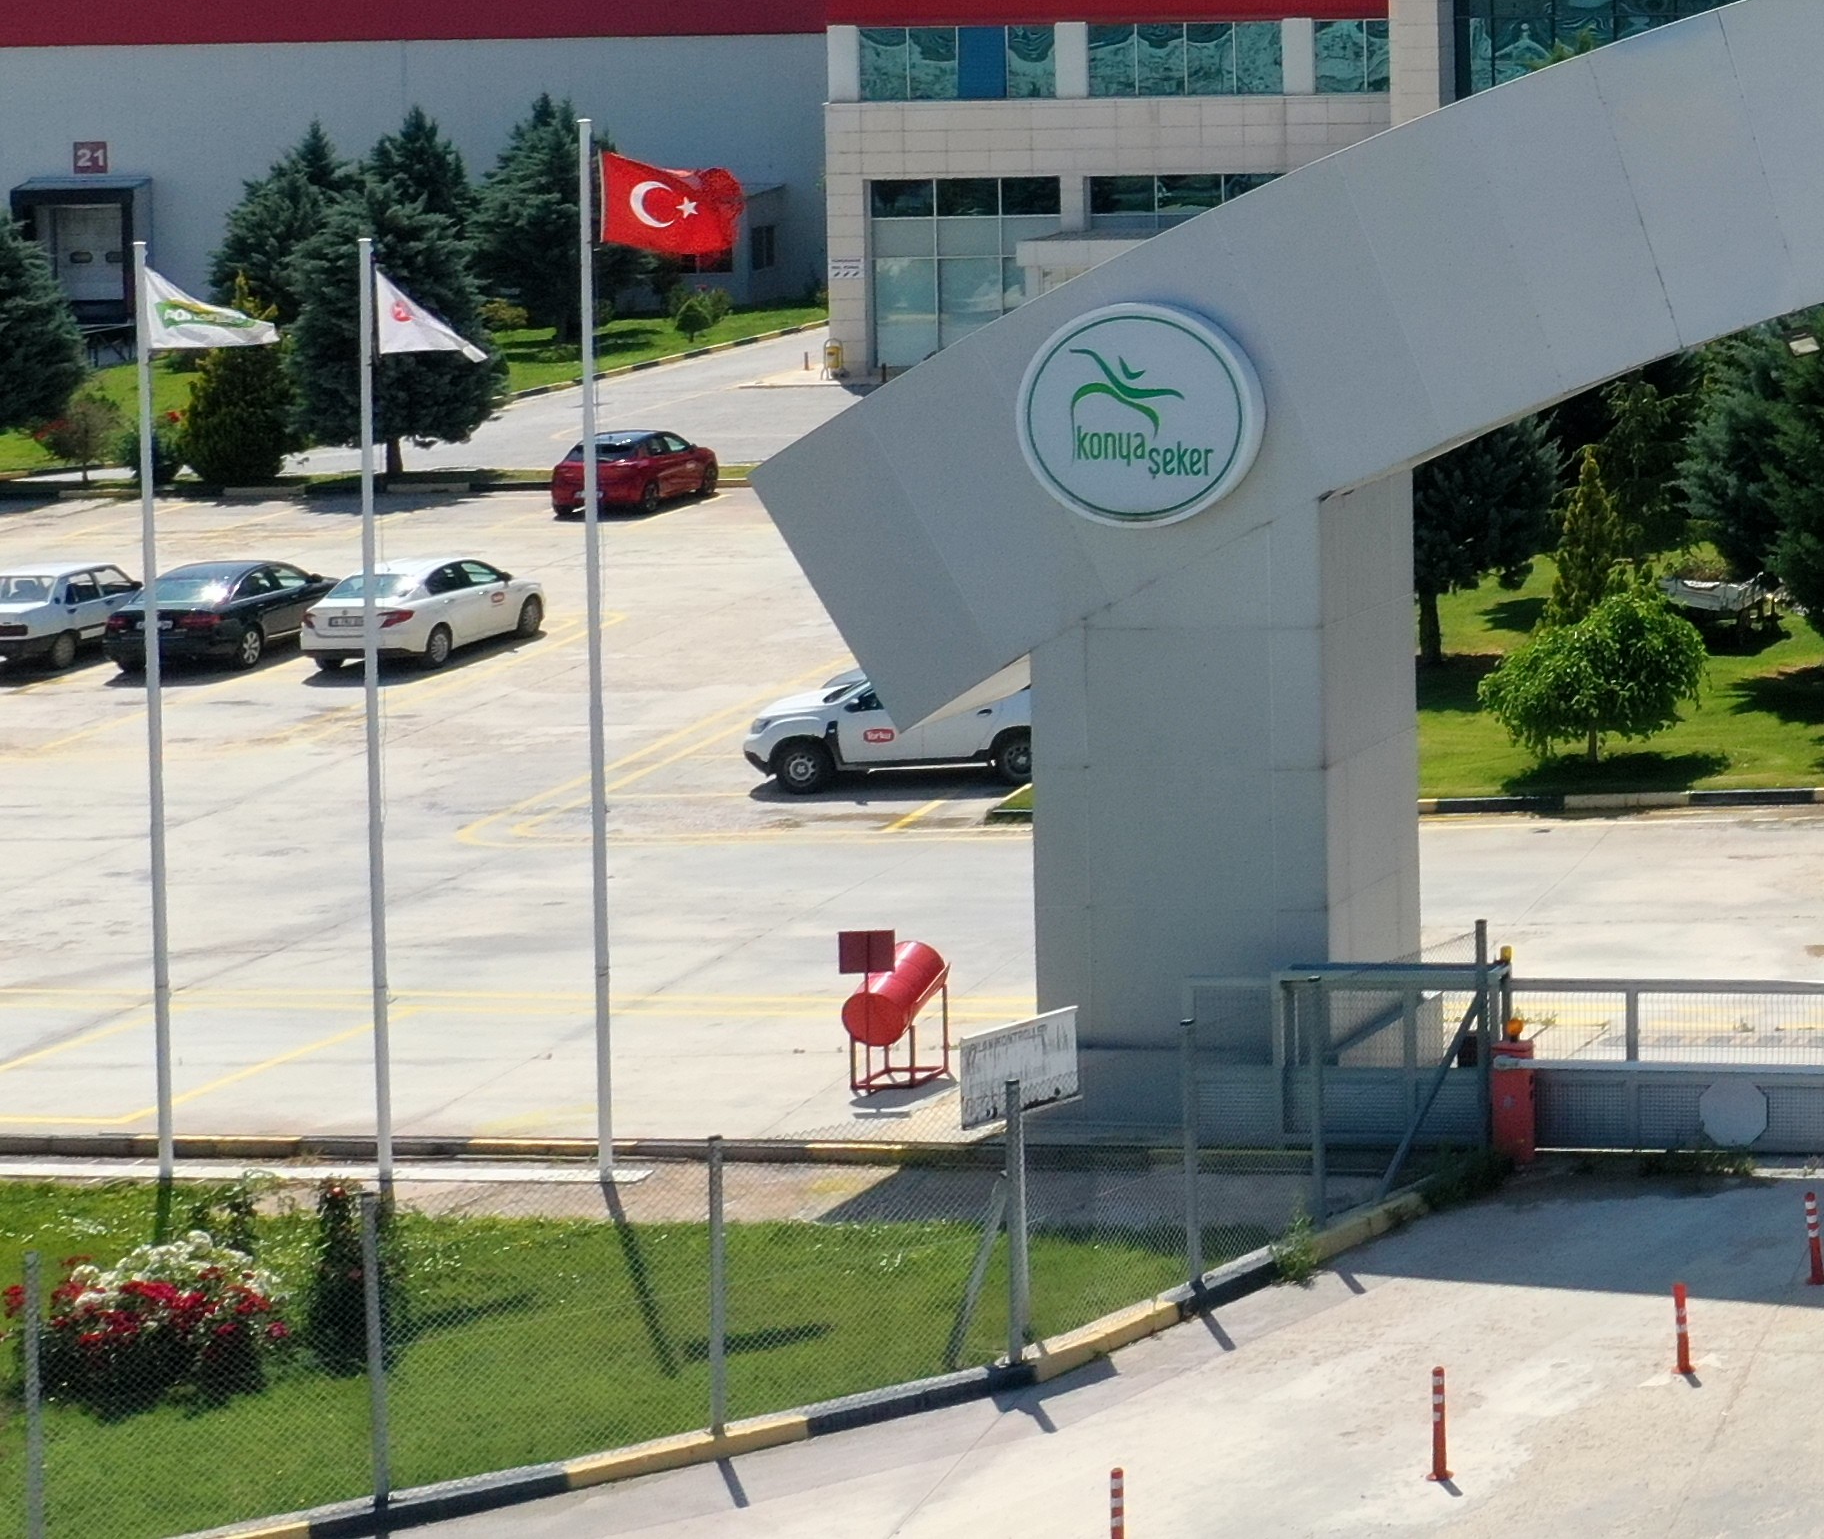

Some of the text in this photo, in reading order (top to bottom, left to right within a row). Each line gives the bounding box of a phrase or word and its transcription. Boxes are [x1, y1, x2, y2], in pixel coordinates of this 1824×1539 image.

[77, 148, 105, 167] 21
[1076, 424, 1215, 480] konya şeker
